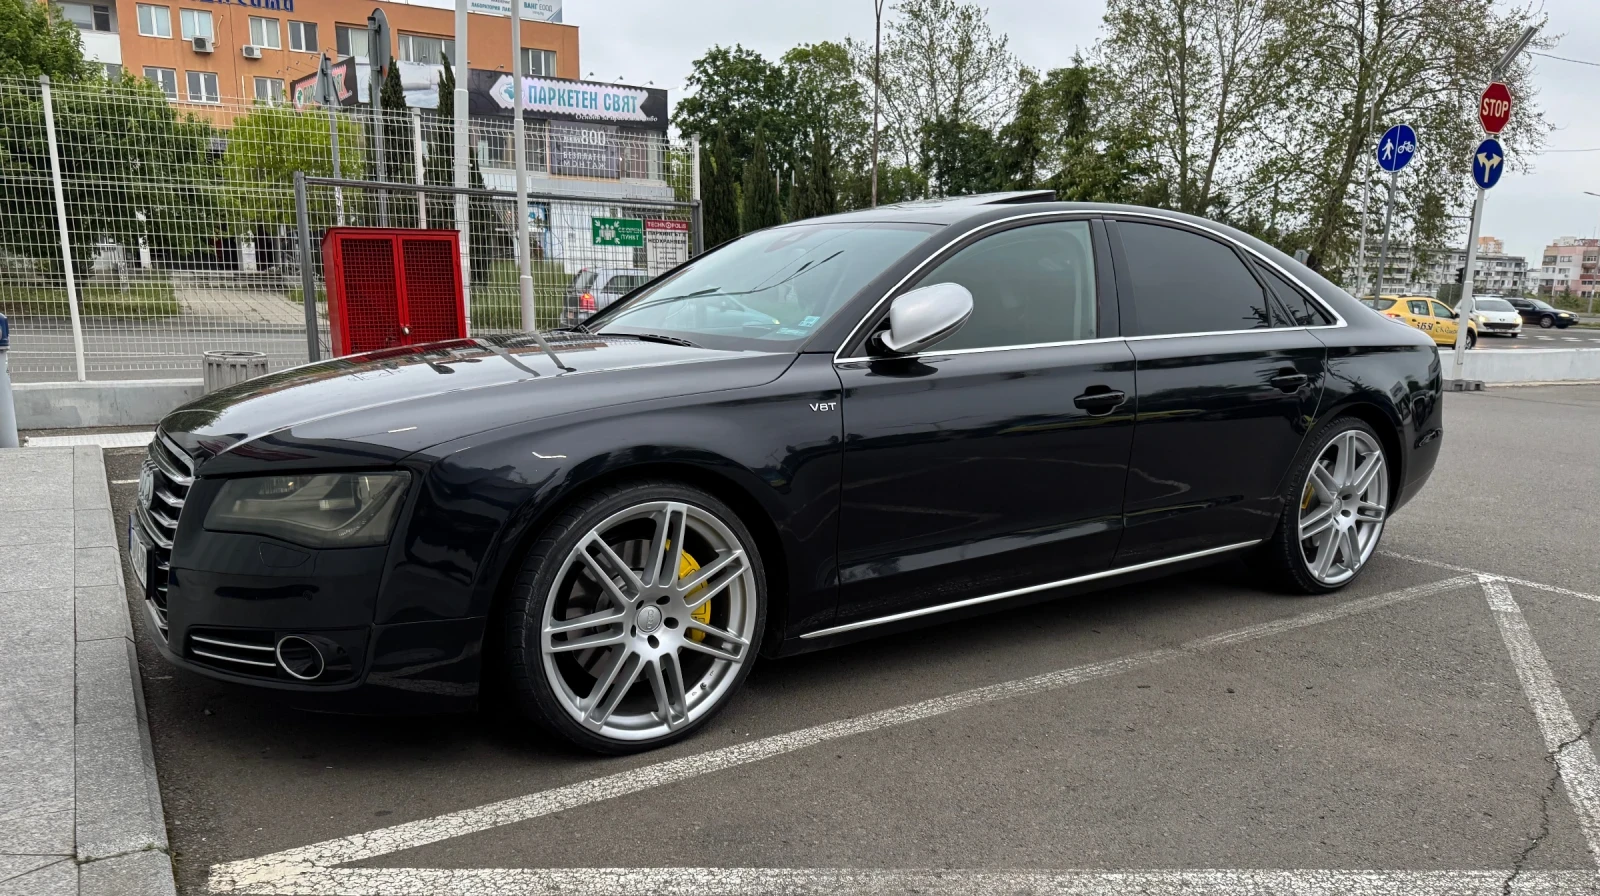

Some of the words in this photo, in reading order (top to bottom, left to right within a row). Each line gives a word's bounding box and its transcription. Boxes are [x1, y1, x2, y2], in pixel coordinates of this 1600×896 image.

[529, 85, 598, 109] ПАРКЕТЕН
[603, 93, 637, 113] СВЯТ
[1482, 97, 1509, 118] STOP
[581, 129, 606, 146] 800
[563, 151, 606, 162] БЕЗПЛАТЕН
[563, 160, 606, 170] МОНТАЖ
[809, 402, 837, 412] V8T
